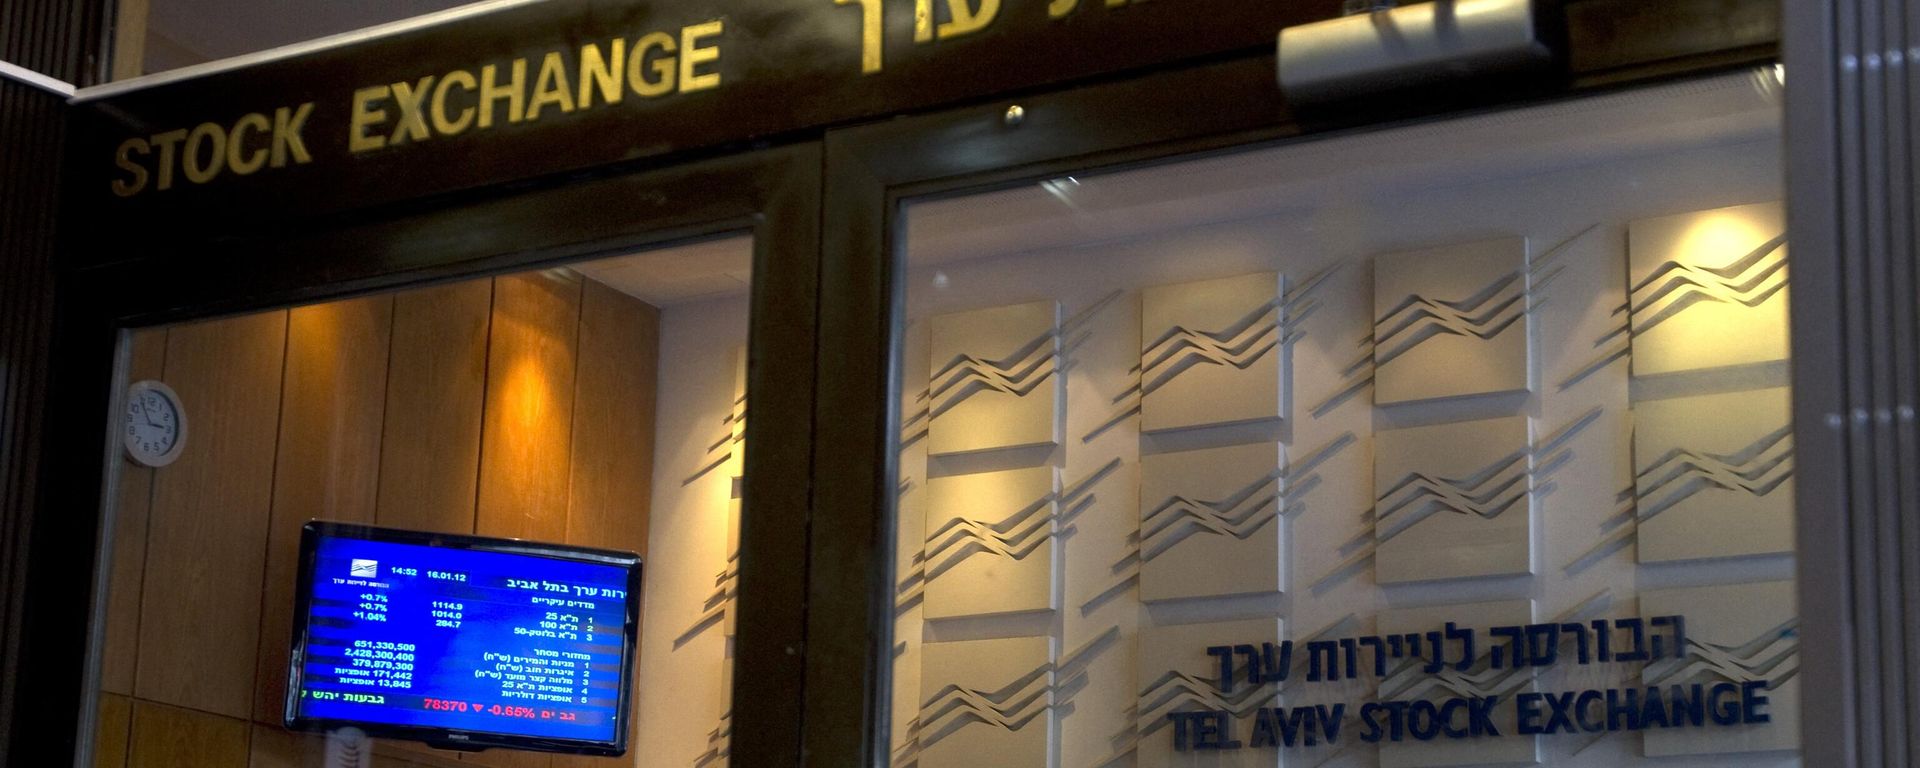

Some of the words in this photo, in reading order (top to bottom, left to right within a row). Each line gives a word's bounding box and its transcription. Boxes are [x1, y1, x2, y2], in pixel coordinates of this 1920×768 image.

[111, 103, 313, 197] STOCK
[348, 20, 724, 154] EXCHANGE
[391, 566, 418, 576] 14:52
[427, 570, 466, 582] 16.01.12
[507, 579, 538, 590] אביב
[542, 580, 569, 593] בתל
[573, 585, 598, 597] ערך
[360, 593, 388, 603] +0.7%
[531, 596, 564, 606] עיקריים
[359, 602, 388, 612] +0.7%
[567, 600, 595, 609] מדדים
[353, 611, 387, 622] +1.04%
[431, 610, 462, 620] 1014.0
[545, 612, 557, 621] 25
[539, 620, 557, 629] 100
[1489, 615, 1686, 669] הבורסה
[534, 648, 559, 657] מסחר
[1306, 622, 1474, 682] לניירות
[525, 666, 541, 674] חוב
[1206, 640, 1293, 693] ערך
[373, 670, 413, 680] 171,442
[378, 678, 412, 689] 13,845
[502, 680, 514, 688] 25
[312, 690, 339, 700] יהש
[343, 693, 385, 704] גבעות
[487, 704, 536, 719] -0.65%
[1167, 710, 1241, 752] TEL
[1249, 703, 1346, 747] AVIV
[1359, 694, 1500, 743] STOCK
[1516, 680, 1771, 736] EXCHANGE
